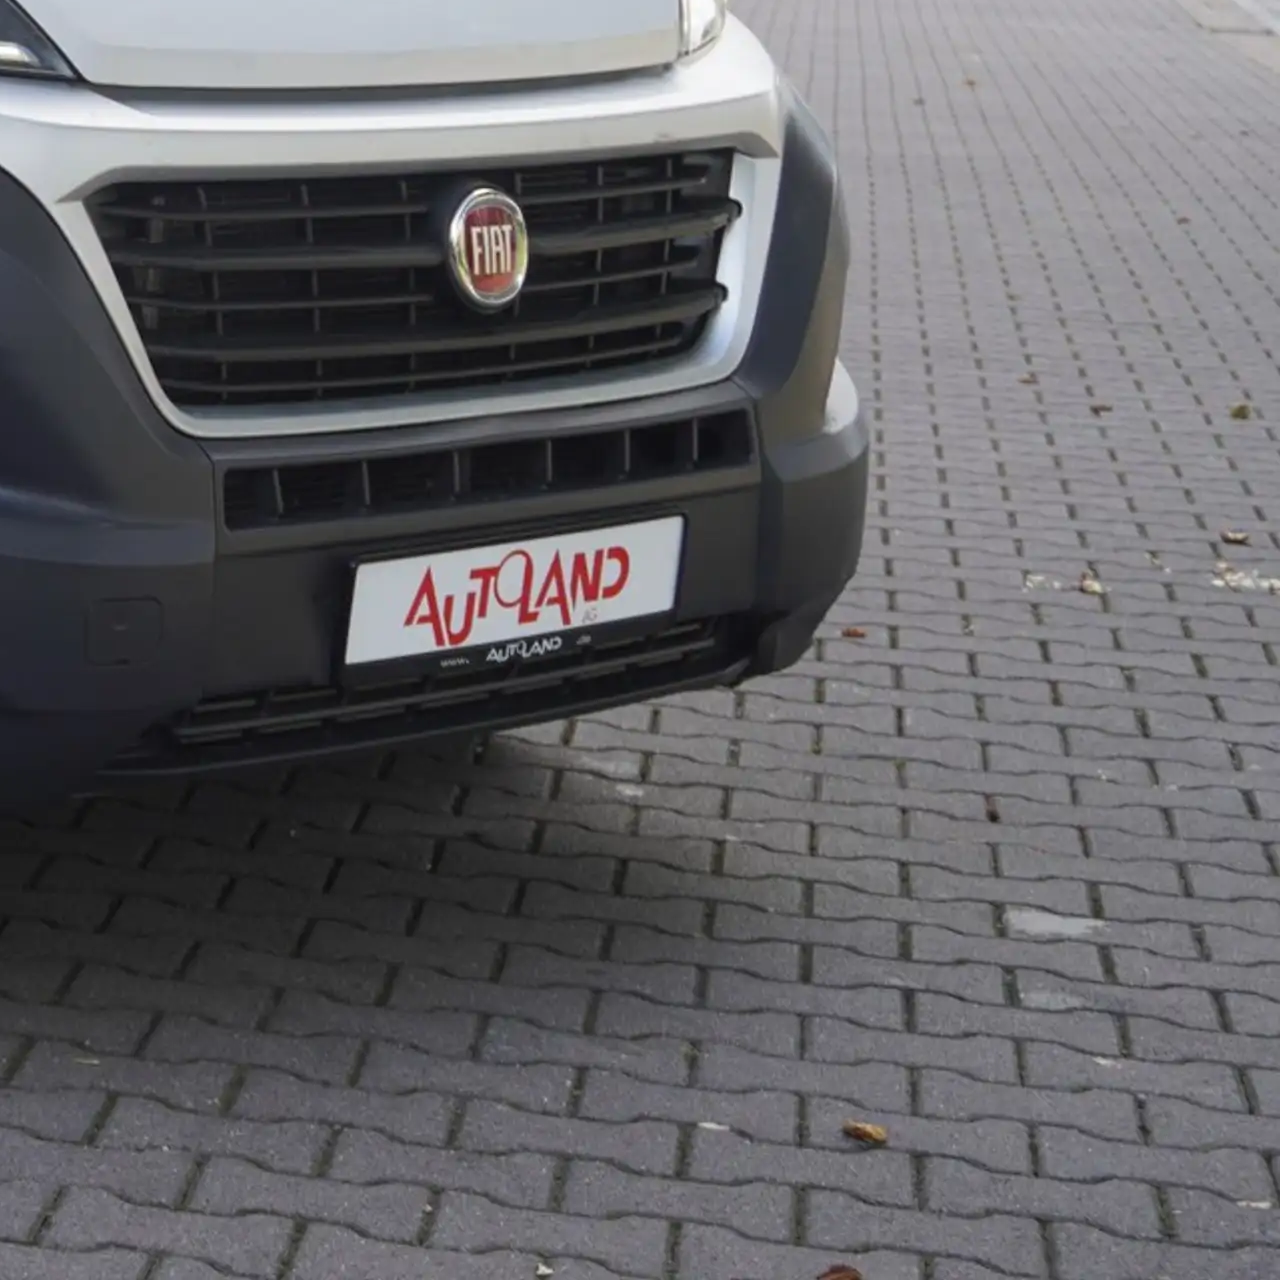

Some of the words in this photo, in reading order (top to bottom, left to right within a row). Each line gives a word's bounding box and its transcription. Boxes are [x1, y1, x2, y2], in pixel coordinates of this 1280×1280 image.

[470, 224, 513, 276] FIAT
[403, 545, 631, 647] AUTOLAND
[485, 635, 564, 664] AUTOLAND
